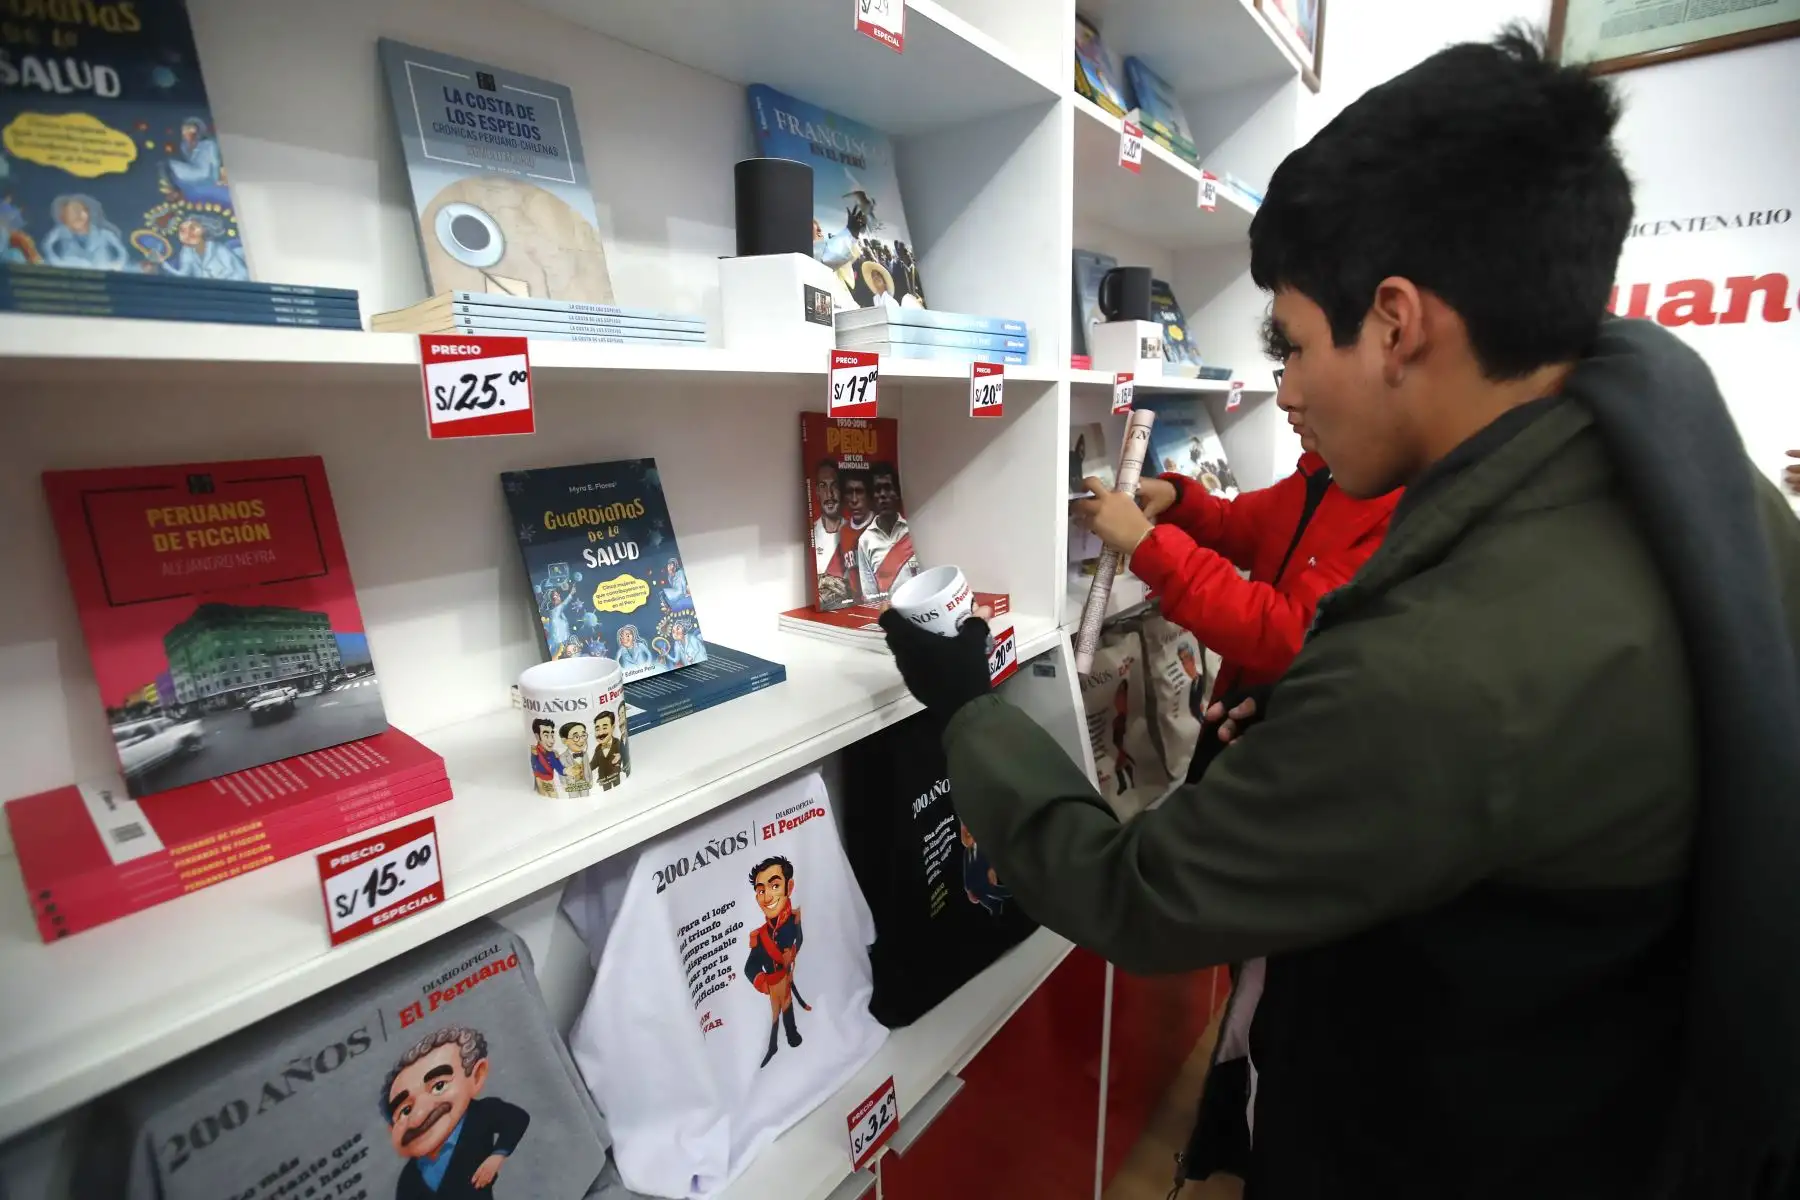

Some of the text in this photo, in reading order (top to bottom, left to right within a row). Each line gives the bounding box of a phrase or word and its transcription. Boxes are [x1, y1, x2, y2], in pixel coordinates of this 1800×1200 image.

[873, 27, 900, 47] ESPECIAL
[443, 86, 536, 122] LA COSTA DE
[445, 107, 542, 141] LOS ESPEJOS
[1627, 208, 1792, 238] ICENTENARIO
[1605, 272, 1800, 327] uan
[431, 344, 482, 355] PRECIO
[569, 485, 587, 494] Myra
[145, 499, 266, 528] PERUANOS
[152, 521, 272, 552] DE FICCIÓN
[582, 541, 639, 569] SALUD
[908, 609, 940, 624] ÑOS
[946, 601, 956, 611] El
[541, 698, 588, 713] AÑOS
[599, 692, 608, 704] El
[929, 779, 951, 805] AÑO
[775, 798, 814, 820] DIARIO OFICIAL
[762, 808, 826, 840] El Peruano
[330, 842, 386, 869] PRECIO
[652, 830, 749, 894] 200 AÑOS
[372, 893, 438, 926] ESPECIAL
[701, 912, 711, 922] el
[711, 900, 736, 917] logro
[683, 921, 744, 964] empre ha sido
[688, 920, 721, 943] triunfo
[422, 944, 502, 994] DIARIO OFICIAL
[687, 937, 737, 976] dispensable
[702, 960, 718, 975] por
[719, 954, 729, 964] la
[705, 973, 716, 985] de
[717, 965, 732, 977] los
[398, 952, 519, 1029] El Peruano
[161, 1026, 372, 1175] 200 AÑOS
[852, 1100, 874, 1123] PRECIO
[331, 1133, 362, 1158] que
[318, 1146, 369, 1188] hacer
[336, 1172, 362, 1195] los
